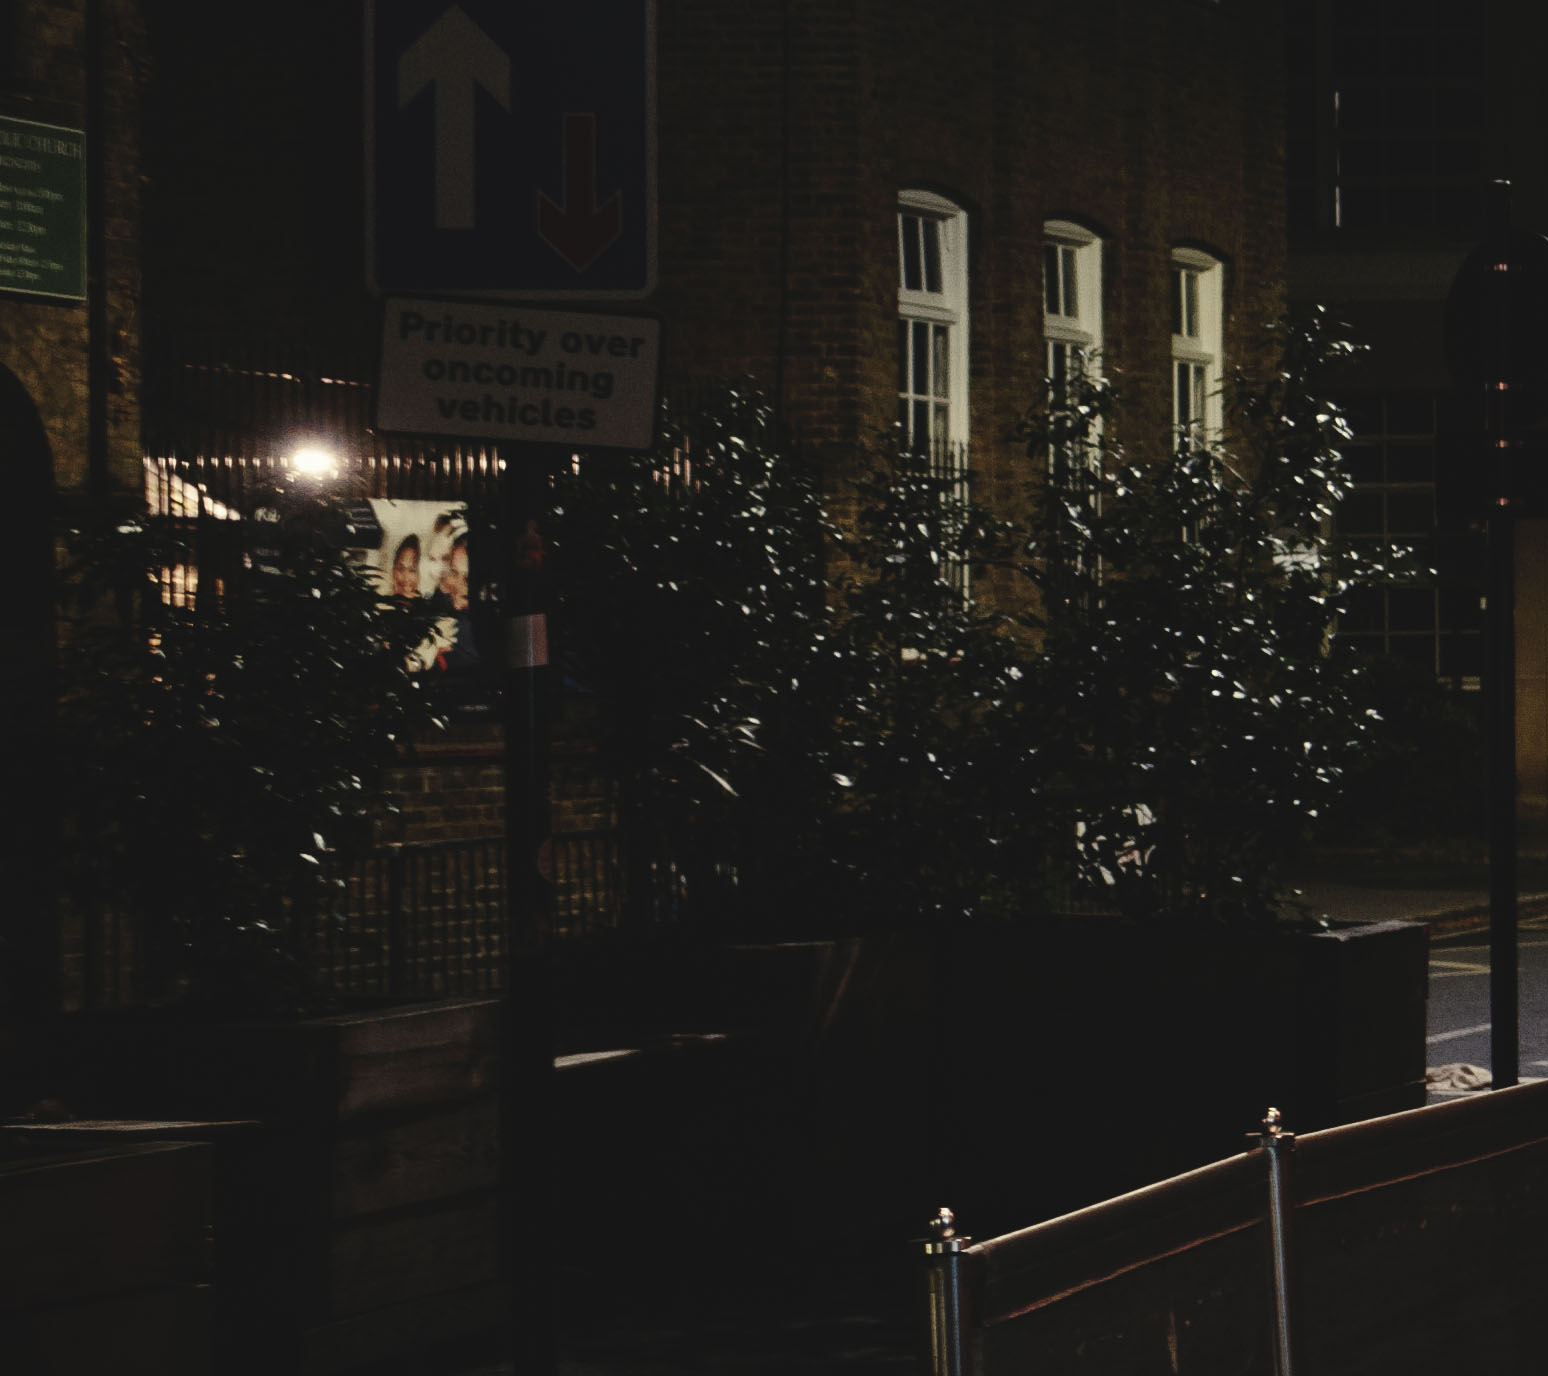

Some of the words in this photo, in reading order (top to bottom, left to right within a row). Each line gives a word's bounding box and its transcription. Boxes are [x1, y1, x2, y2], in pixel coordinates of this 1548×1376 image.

[398, 310, 548, 356] Priority
[560, 330, 646, 358] over
[422, 357, 615, 399] oncoming
[435, 393, 598, 429] vehicles
